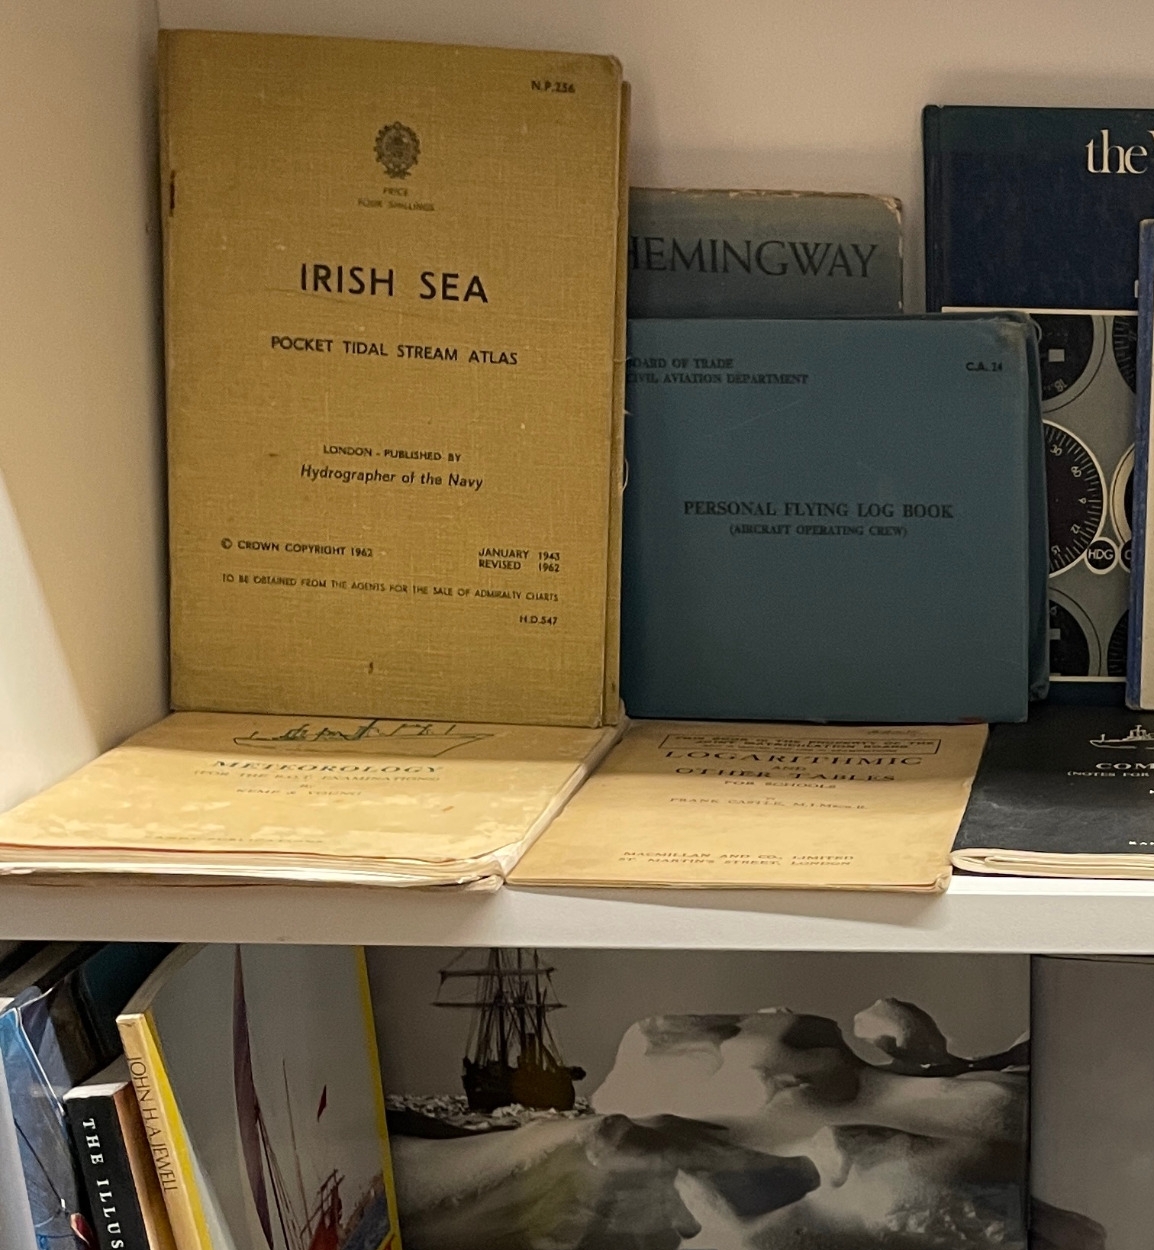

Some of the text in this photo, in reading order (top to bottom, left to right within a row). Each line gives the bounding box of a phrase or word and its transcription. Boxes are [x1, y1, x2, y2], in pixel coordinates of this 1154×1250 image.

[300, 263, 488, 303] IRISH SEA
[271, 336, 518, 365] POCKET TIDAL STREAM ATLAS
[300, 465, 483, 491] Hydrographer of the Navy
[684, 501, 953, 519] PERSONAL FLYING LOG BOOK
[729, 524, 907, 537] (AIRCRAFT OPERATING CREW)
[254, 575, 296, 586] OBTAINED
[301, 579, 326, 588] FROM
[331, 580, 347, 589] THE
[352, 581, 385, 592] AGENTS
[389, 584, 407, 593] FOR
[413, 585, 428, 595] THE
[433, 586, 452, 596] SALE
[457, 588, 470, 596] OF
[474, 589, 521, 599] ADMIRALTY
[525, 591, 558, 602] CHARTS
[82, 1118, 103, 1165] THE
